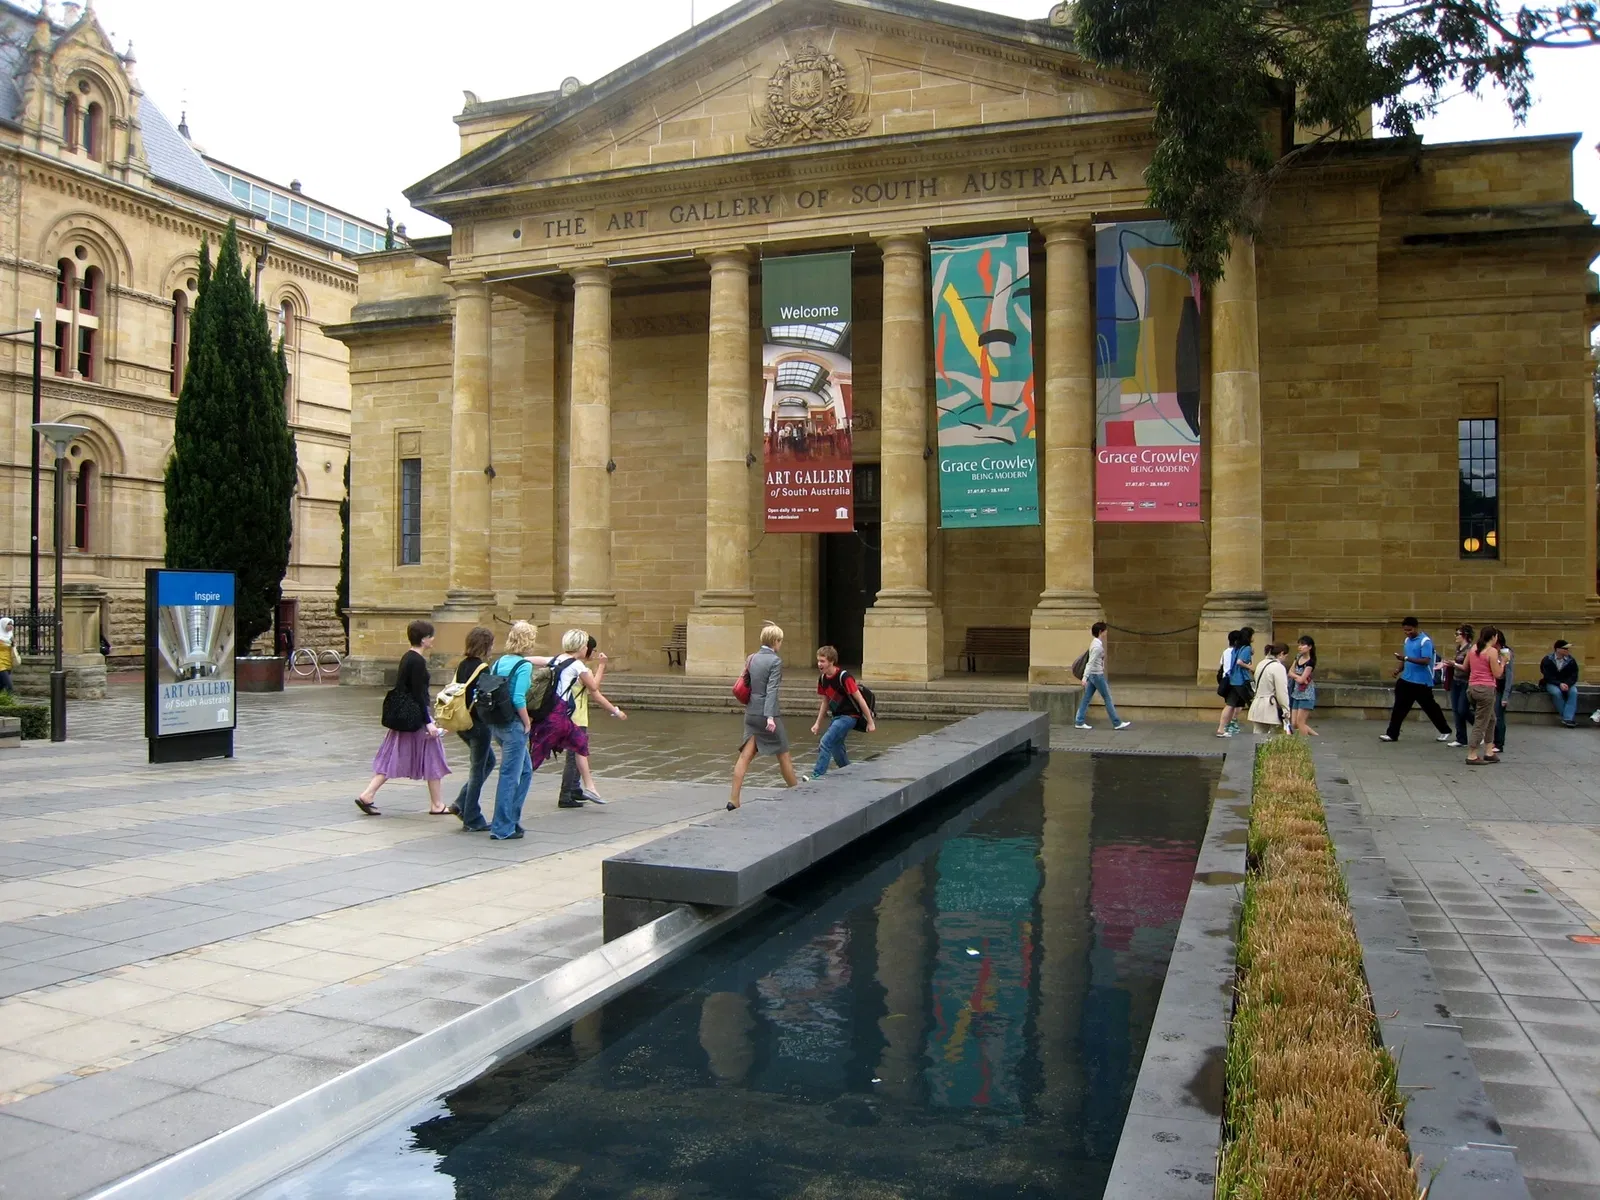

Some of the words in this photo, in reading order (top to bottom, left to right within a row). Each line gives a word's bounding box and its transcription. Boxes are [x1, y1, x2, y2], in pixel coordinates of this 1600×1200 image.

[543, 217, 587, 238] THE
[606, 209, 649, 231] ART
[669, 194, 775, 223] GALLERY
[797, 189, 829, 209] OF
[852, 178, 938, 205] SOUTH
[962, 161, 1118, 193] AUSTRALIA
[780, 305, 839, 320] Welcome
[941, 459, 978, 473] Grace
[981, 455, 1035, 472] Crowley
[1098, 450, 1138, 464] Grace
[1141, 448, 1198, 466] Crowley
[971, 472, 994, 481] BEING
[995, 471, 1028, 480] MODERN
[1130, 465, 1154, 473] BEING
[1155, 465, 1190, 473] MODERN
[766, 470, 791, 485] ART
[795, 469, 852, 484] GALLERY
[770, 488, 781, 499] of
[782, 487, 808, 497] South
[811, 486, 851, 496] Australia
[194, 591, 221, 603] Inspire
[163, 684, 184, 699] ART
[187, 681, 232, 697] GALLERY
[165, 700, 174, 710] of
[175, 697, 198, 708] South
[200, 695, 231, 706] Australia
